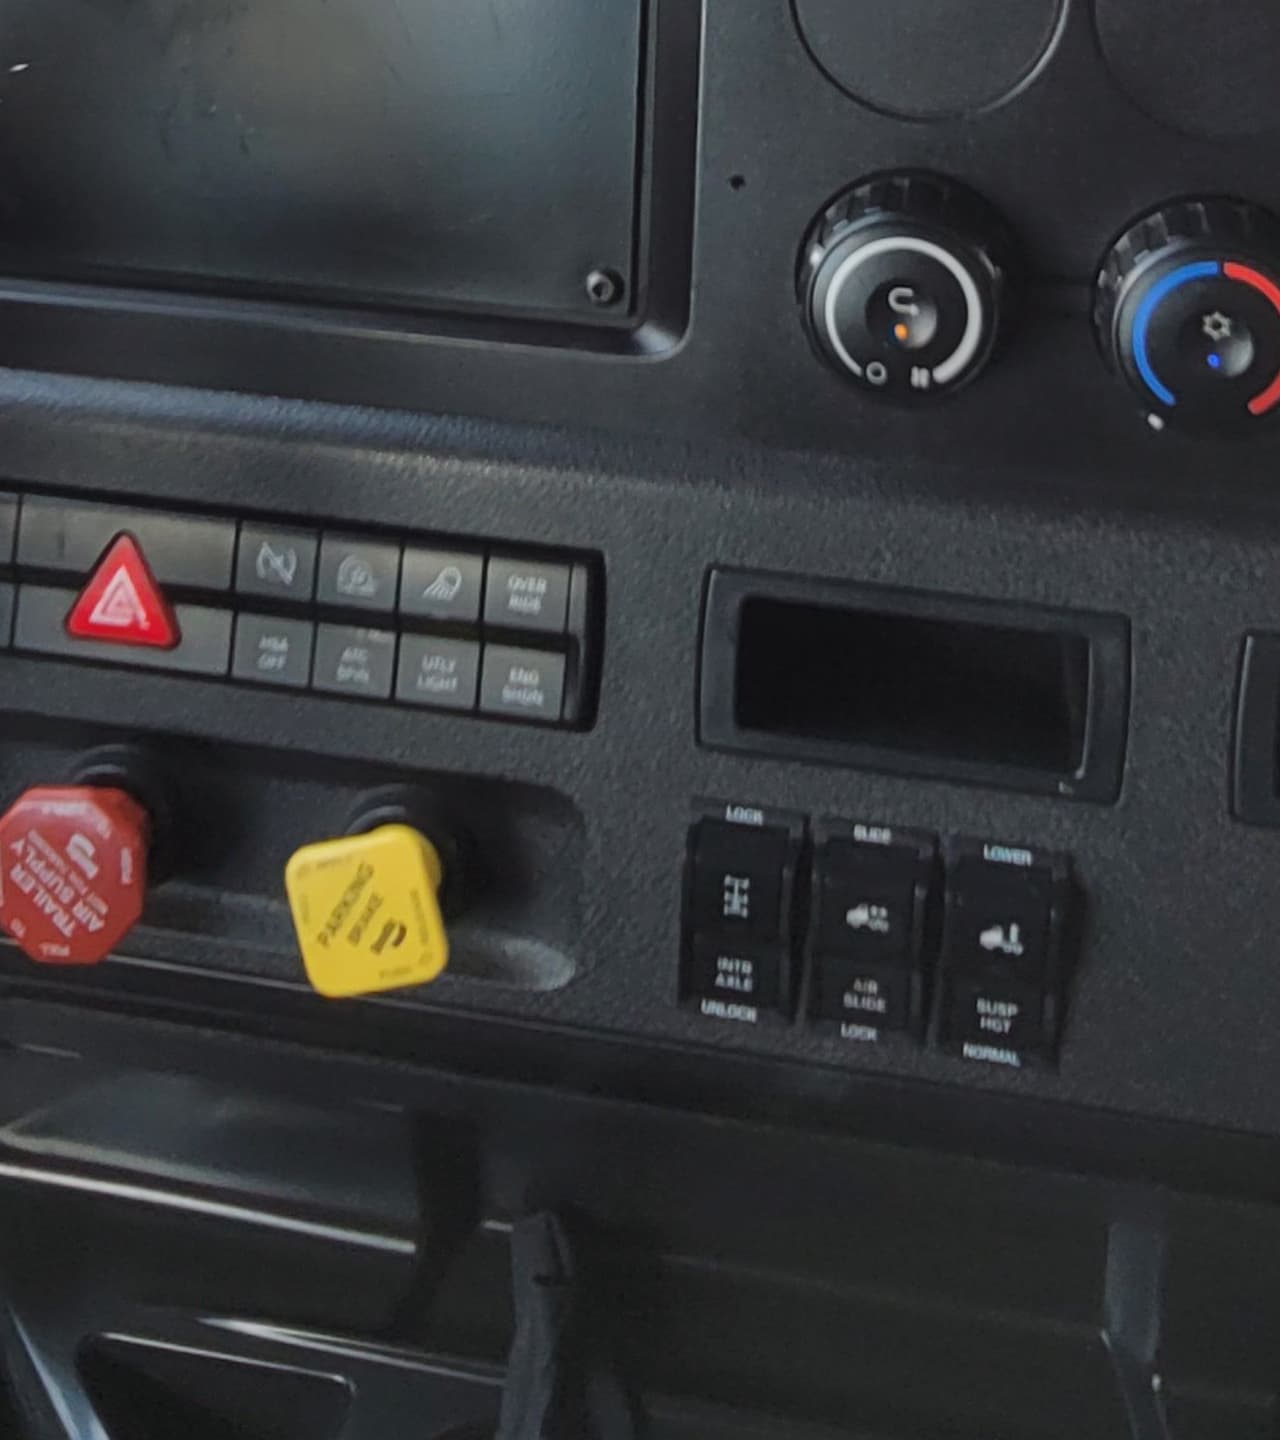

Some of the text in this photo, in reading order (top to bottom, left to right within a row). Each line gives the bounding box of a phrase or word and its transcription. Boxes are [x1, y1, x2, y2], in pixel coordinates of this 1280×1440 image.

[725, 804, 764, 826] LOCK
[983, 843, 1033, 868] LOWER
[10, 837, 75, 905] SUPPLY
[10, 863, 76, 937] TRAILER
[72, 898, 105, 933] AIR
[854, 977, 879, 994] AIR
[701, 998, 758, 1023] UNLOCK
[841, 1021, 878, 1041] LOCK
[963, 1041, 1021, 1067] NORMAL
